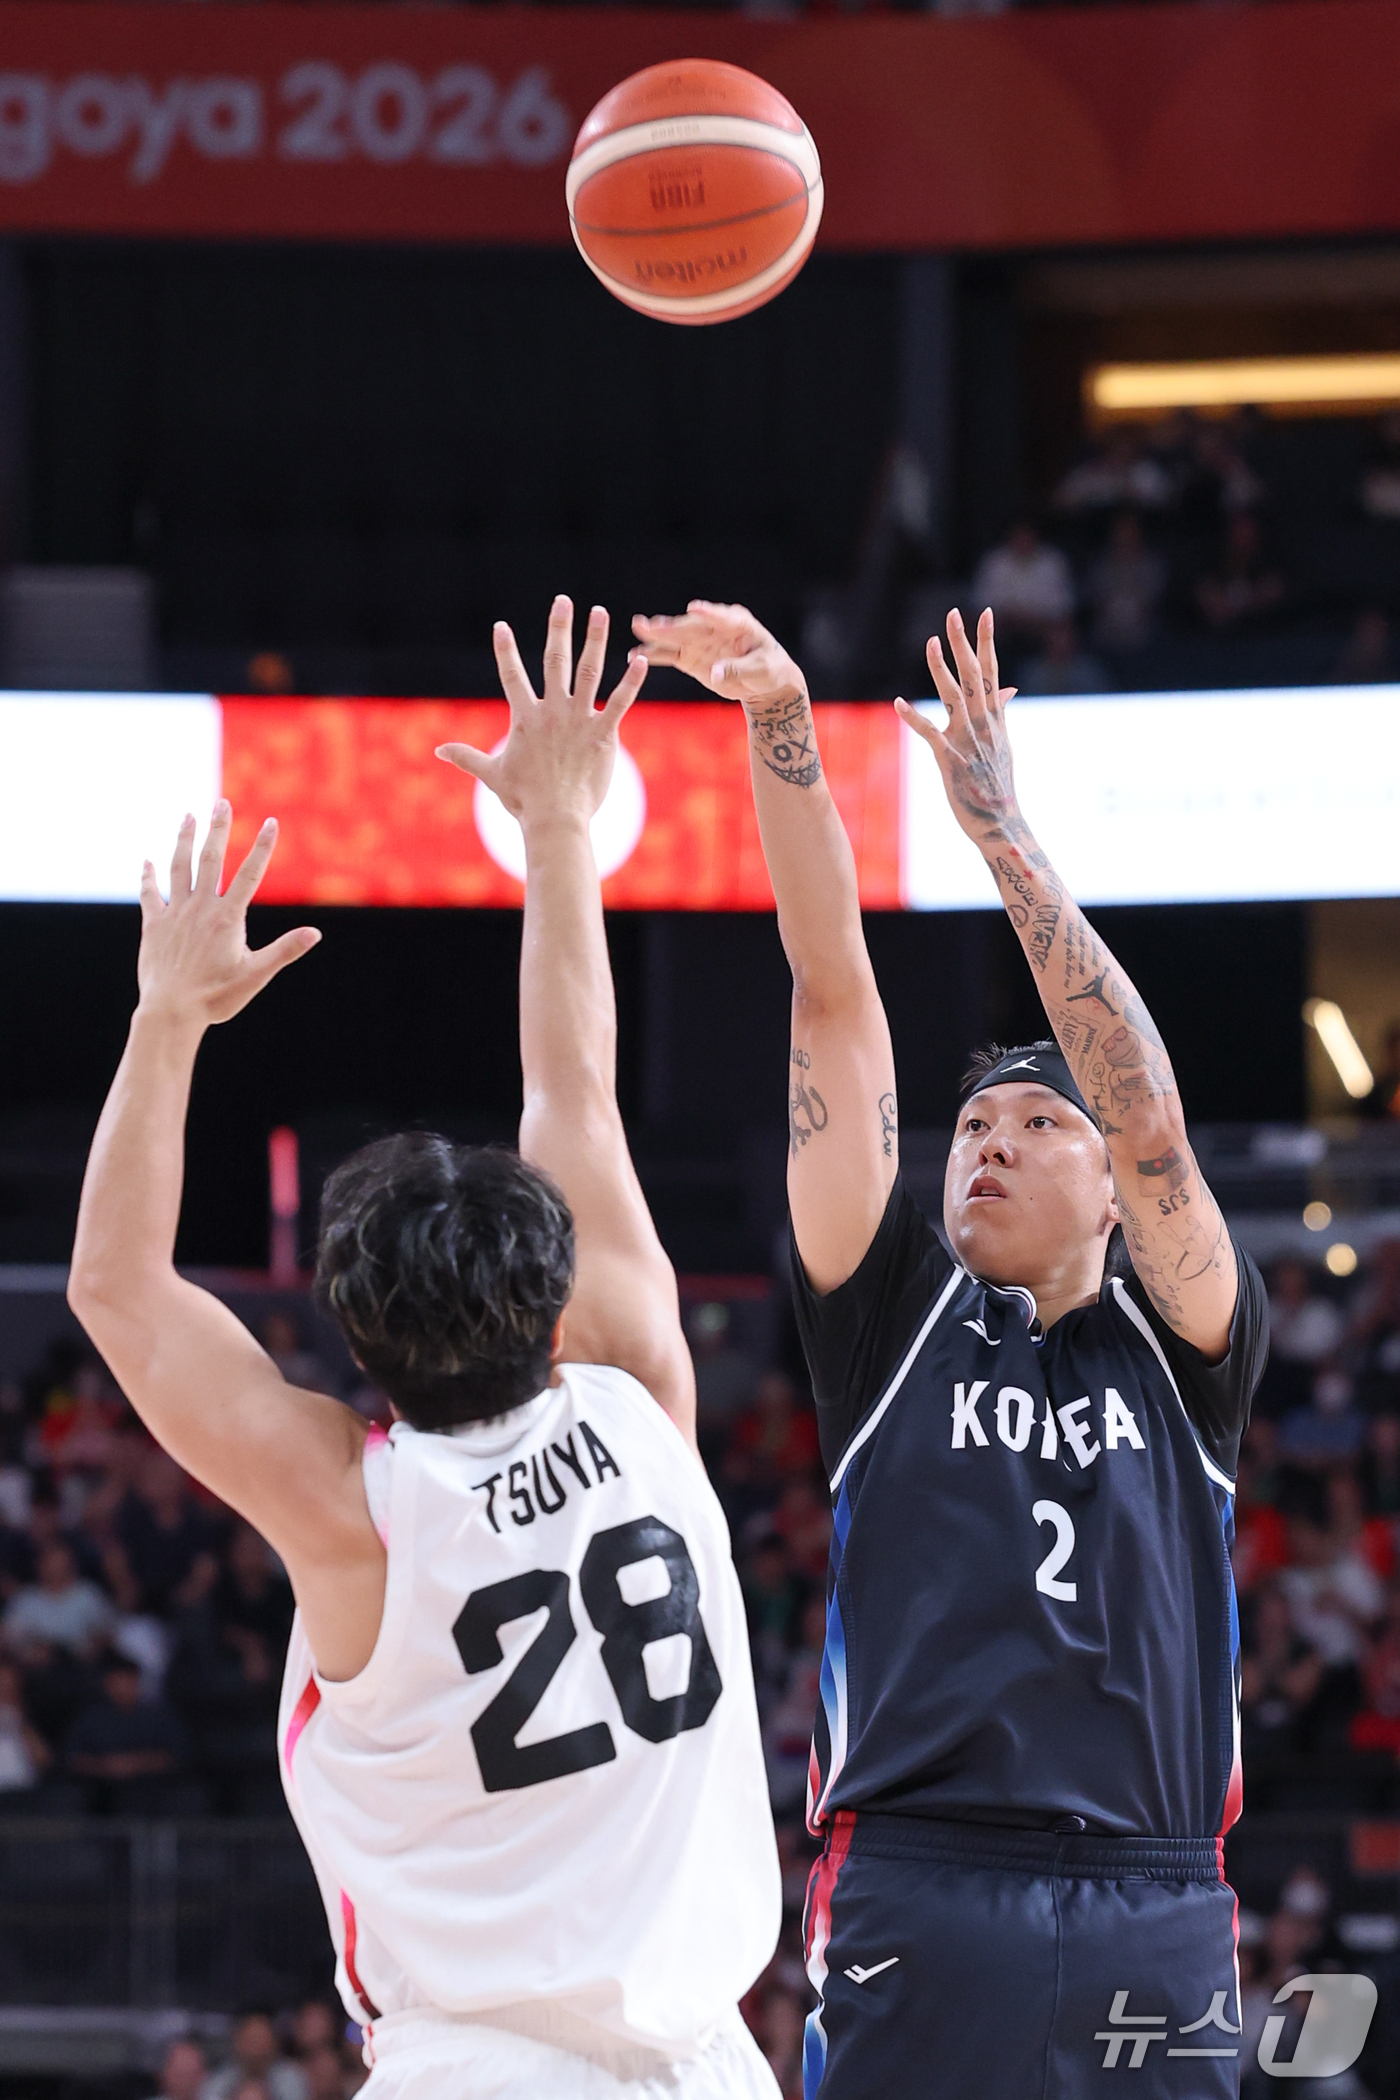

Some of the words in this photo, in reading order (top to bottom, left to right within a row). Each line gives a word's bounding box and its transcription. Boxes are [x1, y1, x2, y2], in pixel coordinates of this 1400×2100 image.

[280, 62, 569, 165] 2026
[634, 246, 748, 283] molten
[1158, 1187, 1190, 1216] SJS
[471, 1420, 621, 1533] TSUYA
[1032, 1499, 1078, 1602] 2
[452, 1515, 723, 1793] 28
